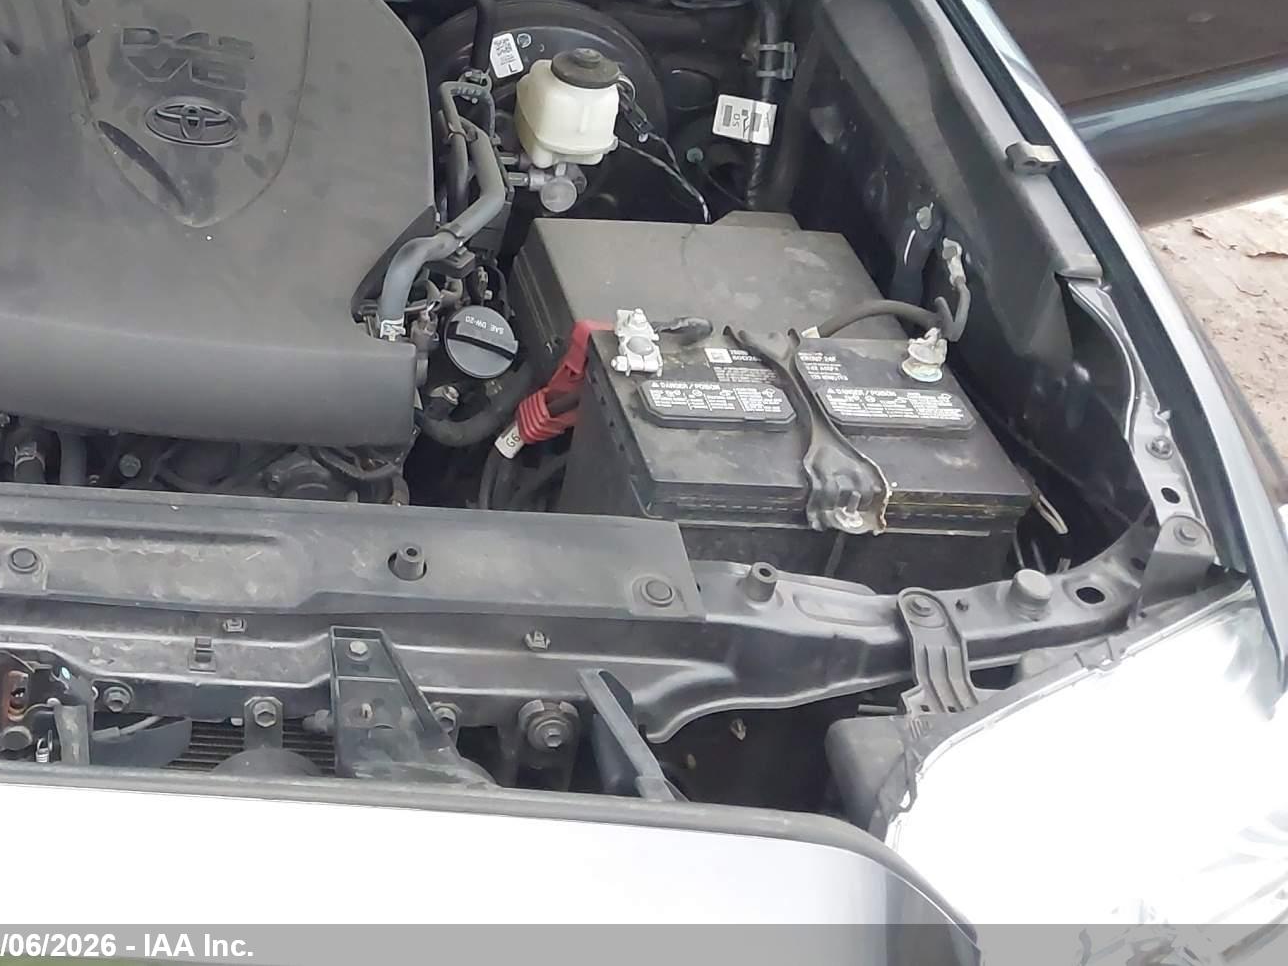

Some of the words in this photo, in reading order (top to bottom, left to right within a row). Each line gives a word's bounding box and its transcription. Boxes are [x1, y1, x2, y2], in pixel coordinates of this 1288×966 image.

[508, 64, 518, 73] L
[465, 315, 487, 329] 0W-20
[490, 324, 504, 335] SAE
